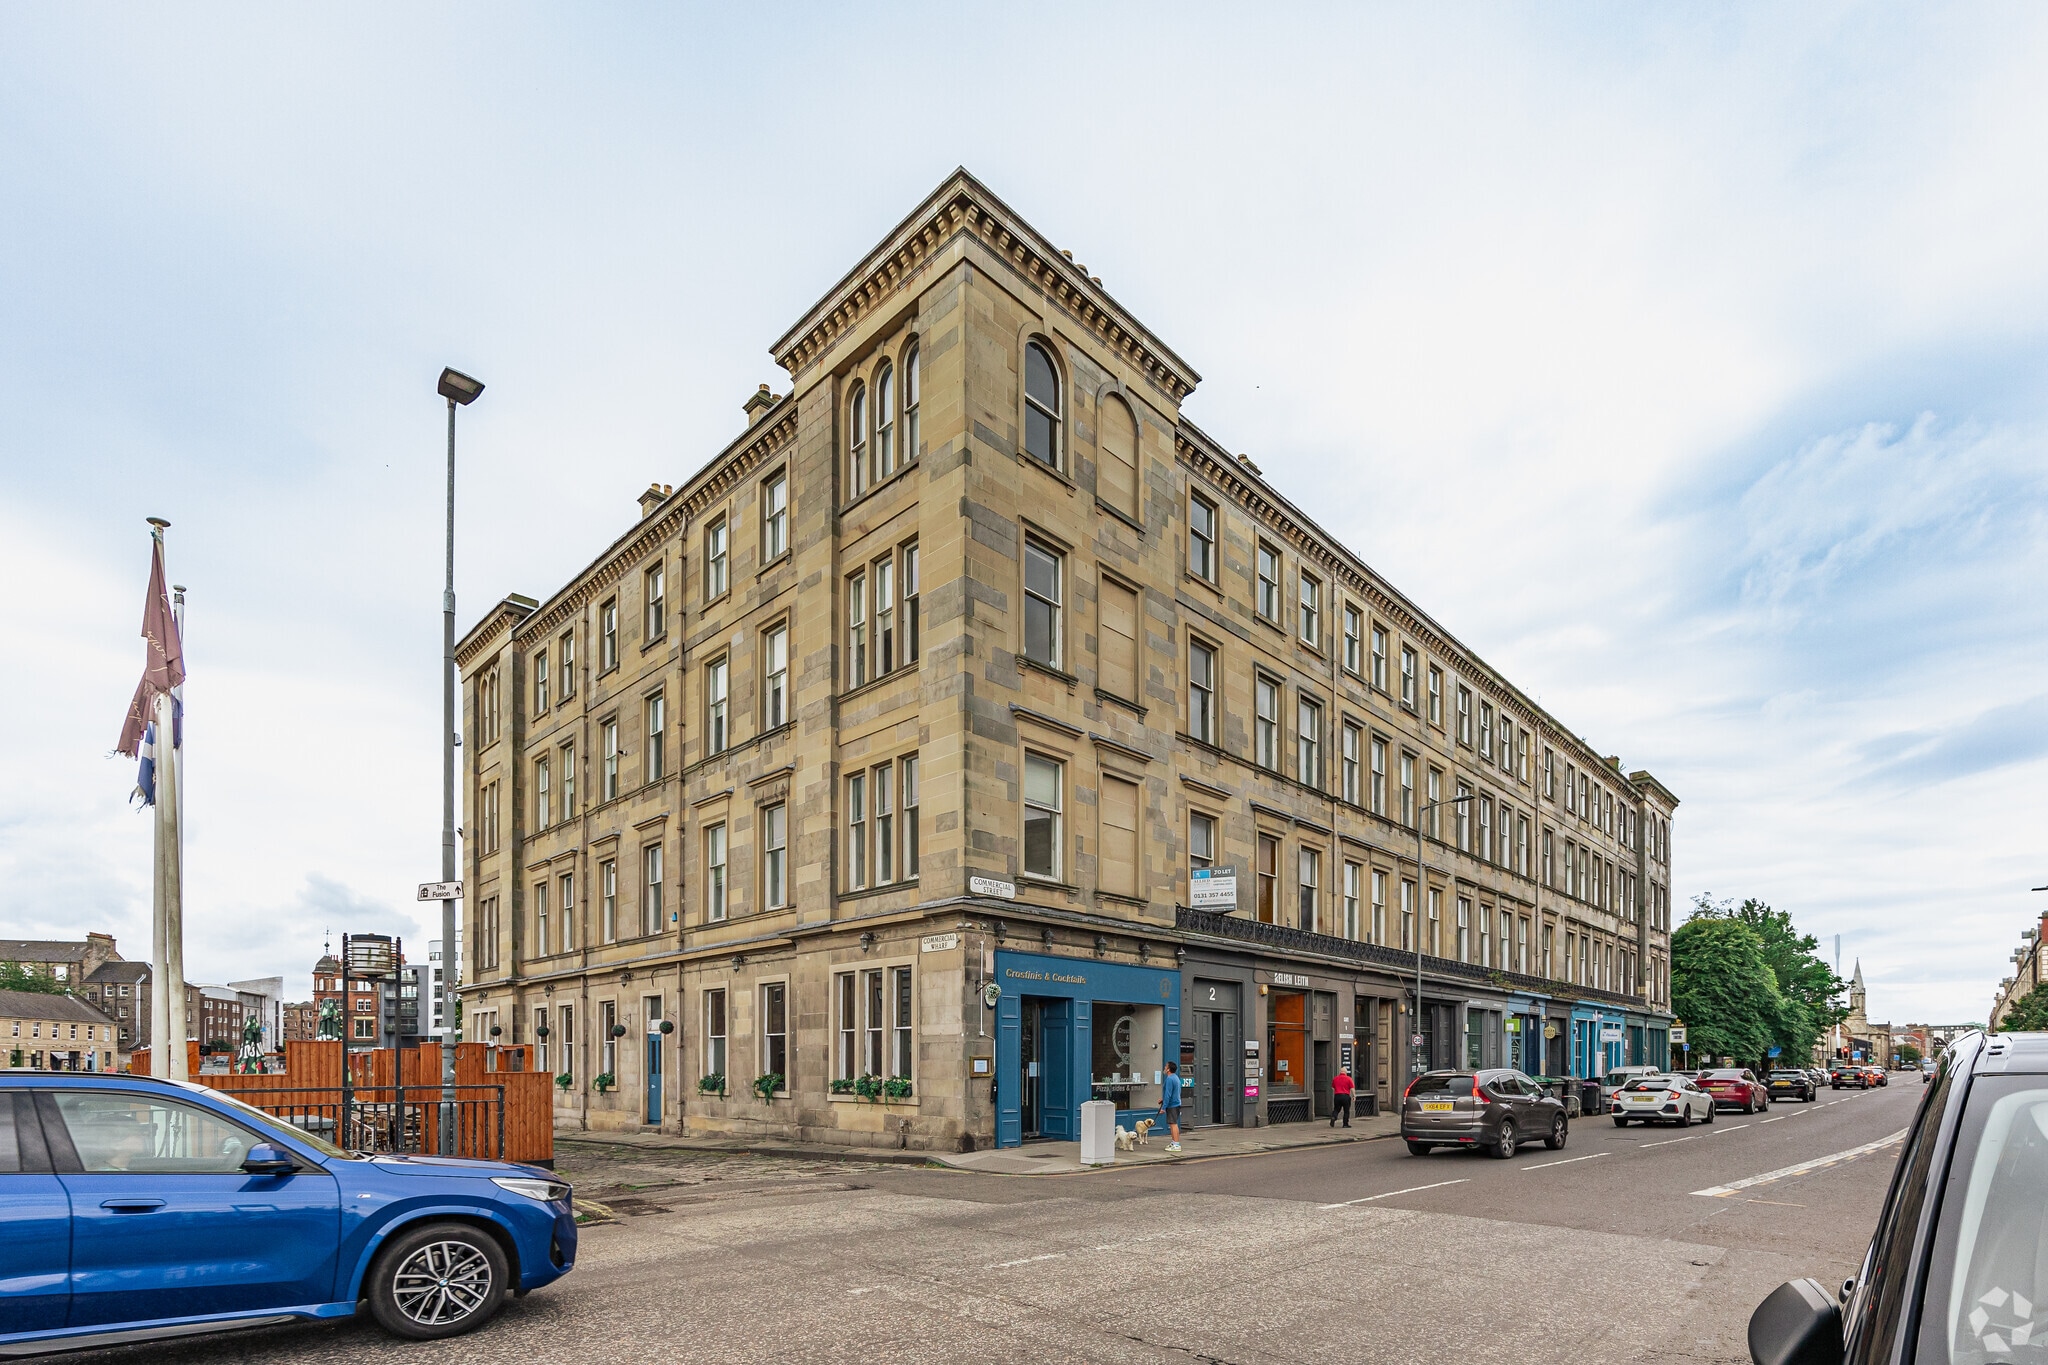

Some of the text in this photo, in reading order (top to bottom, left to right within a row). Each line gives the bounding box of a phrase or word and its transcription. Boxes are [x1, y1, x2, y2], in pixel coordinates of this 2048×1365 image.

[974, 878, 1011, 891] COMMERCIAL
[983, 887, 1003, 895] STREET
[923, 934, 955, 944] COMMERCIAL
[1006, 968, 1086, 984] Crostinis & Cocktails
[1275, 973, 1309, 986] RELISH LEITH
[1209, 987, 1215, 1000] 2
[1182, 1078, 1192, 1087] JSP
